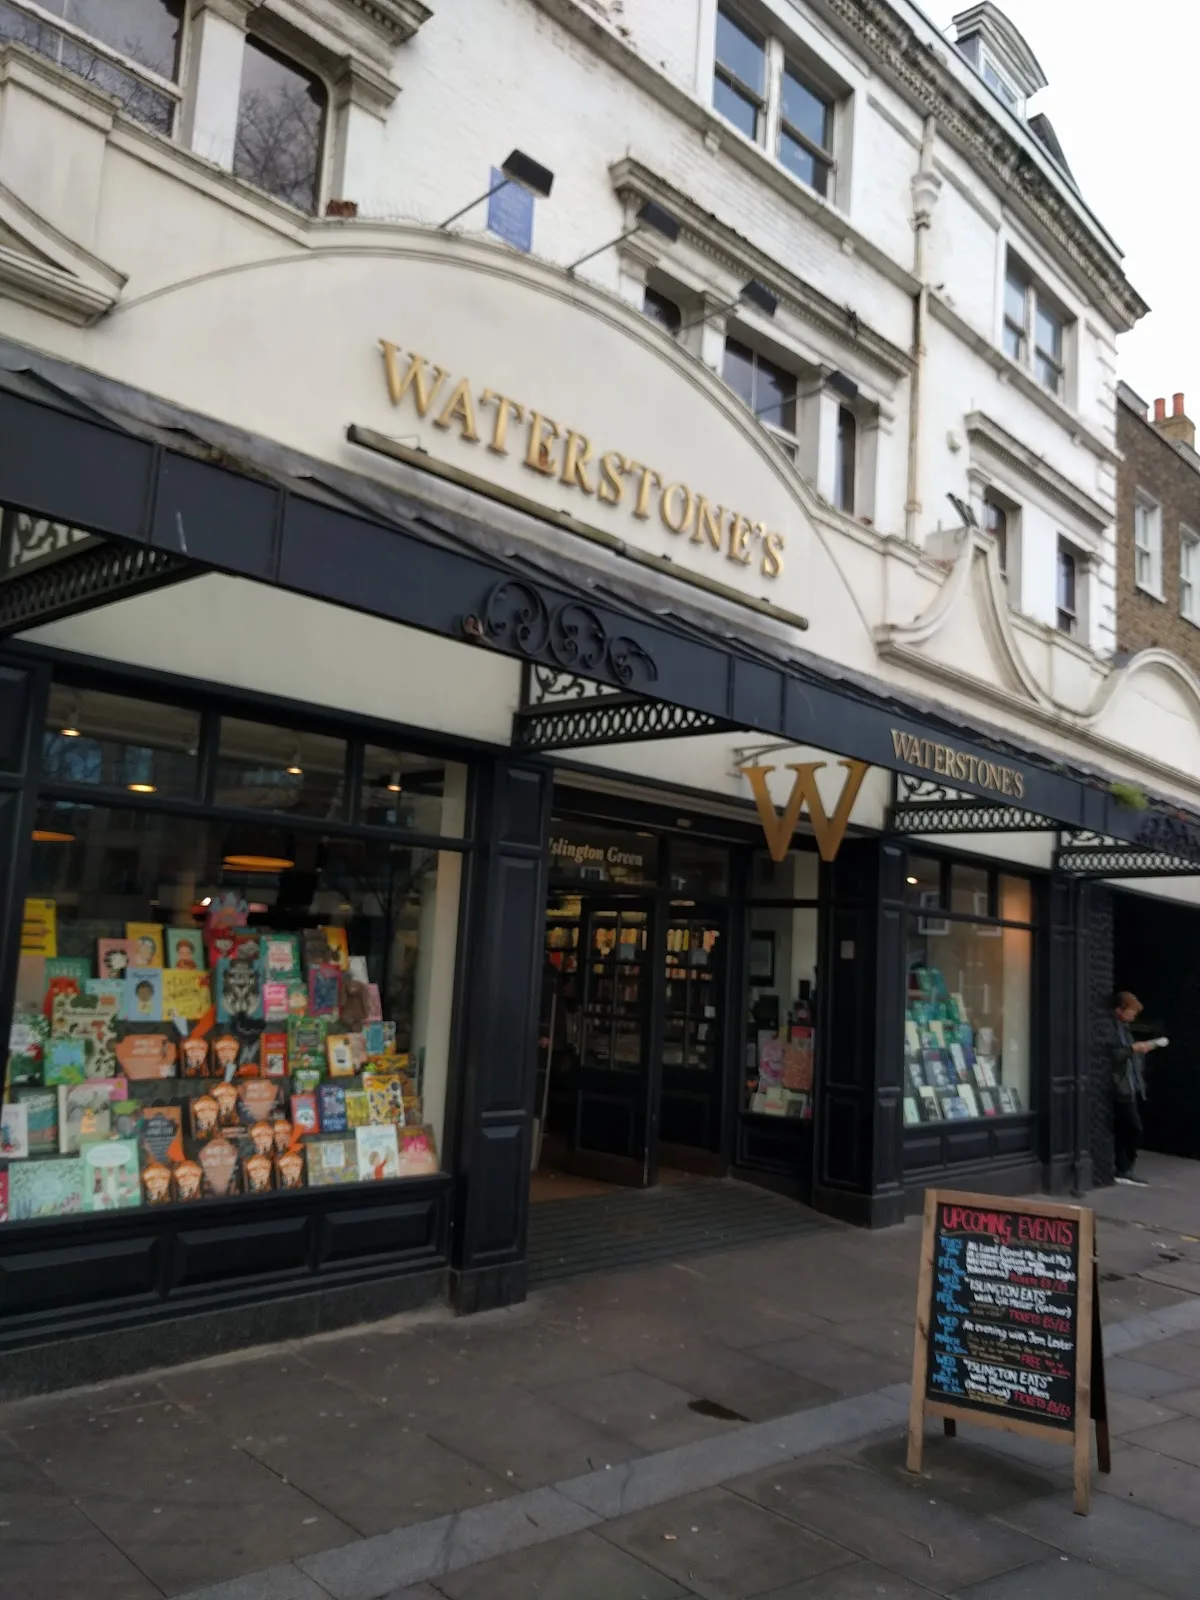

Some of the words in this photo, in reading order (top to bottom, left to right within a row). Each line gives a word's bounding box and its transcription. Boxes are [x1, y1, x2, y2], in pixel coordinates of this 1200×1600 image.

[378, 337, 786, 579] WATERSTONE'S
[889, 727, 1025, 801] WATERSTONE'S
[740, 758, 872, 863] W
[606, 845, 644, 867] Green
[942, 1206, 1012, 1246] UPCOMING
[1018, 1215, 1073, 1245] EVENTS
